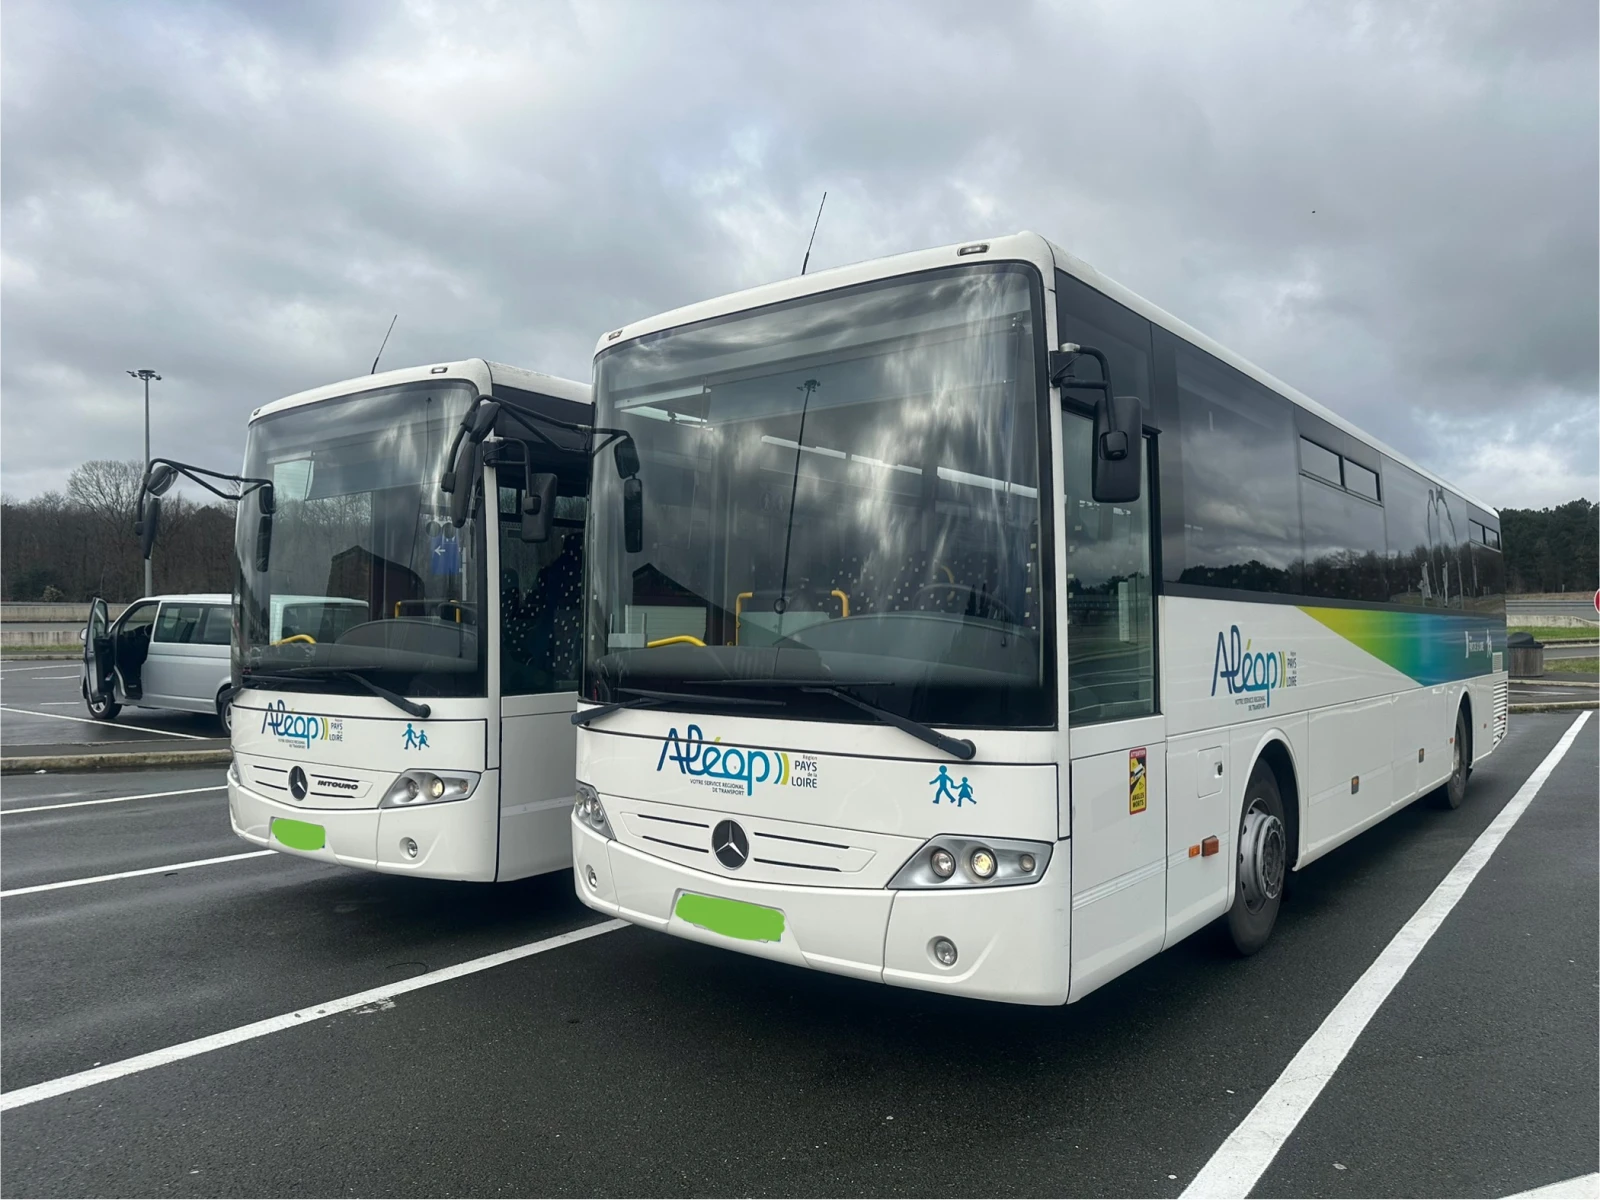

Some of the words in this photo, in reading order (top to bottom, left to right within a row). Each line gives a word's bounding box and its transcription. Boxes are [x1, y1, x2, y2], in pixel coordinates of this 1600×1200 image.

[794, 760, 818, 772] PAYS
[317, 780, 359, 790] INTOURO
[690, 778, 704, 786] VOTRE
[791, 776, 818, 788] LOIRE
[718, 788, 745, 796] TRANSPORT
